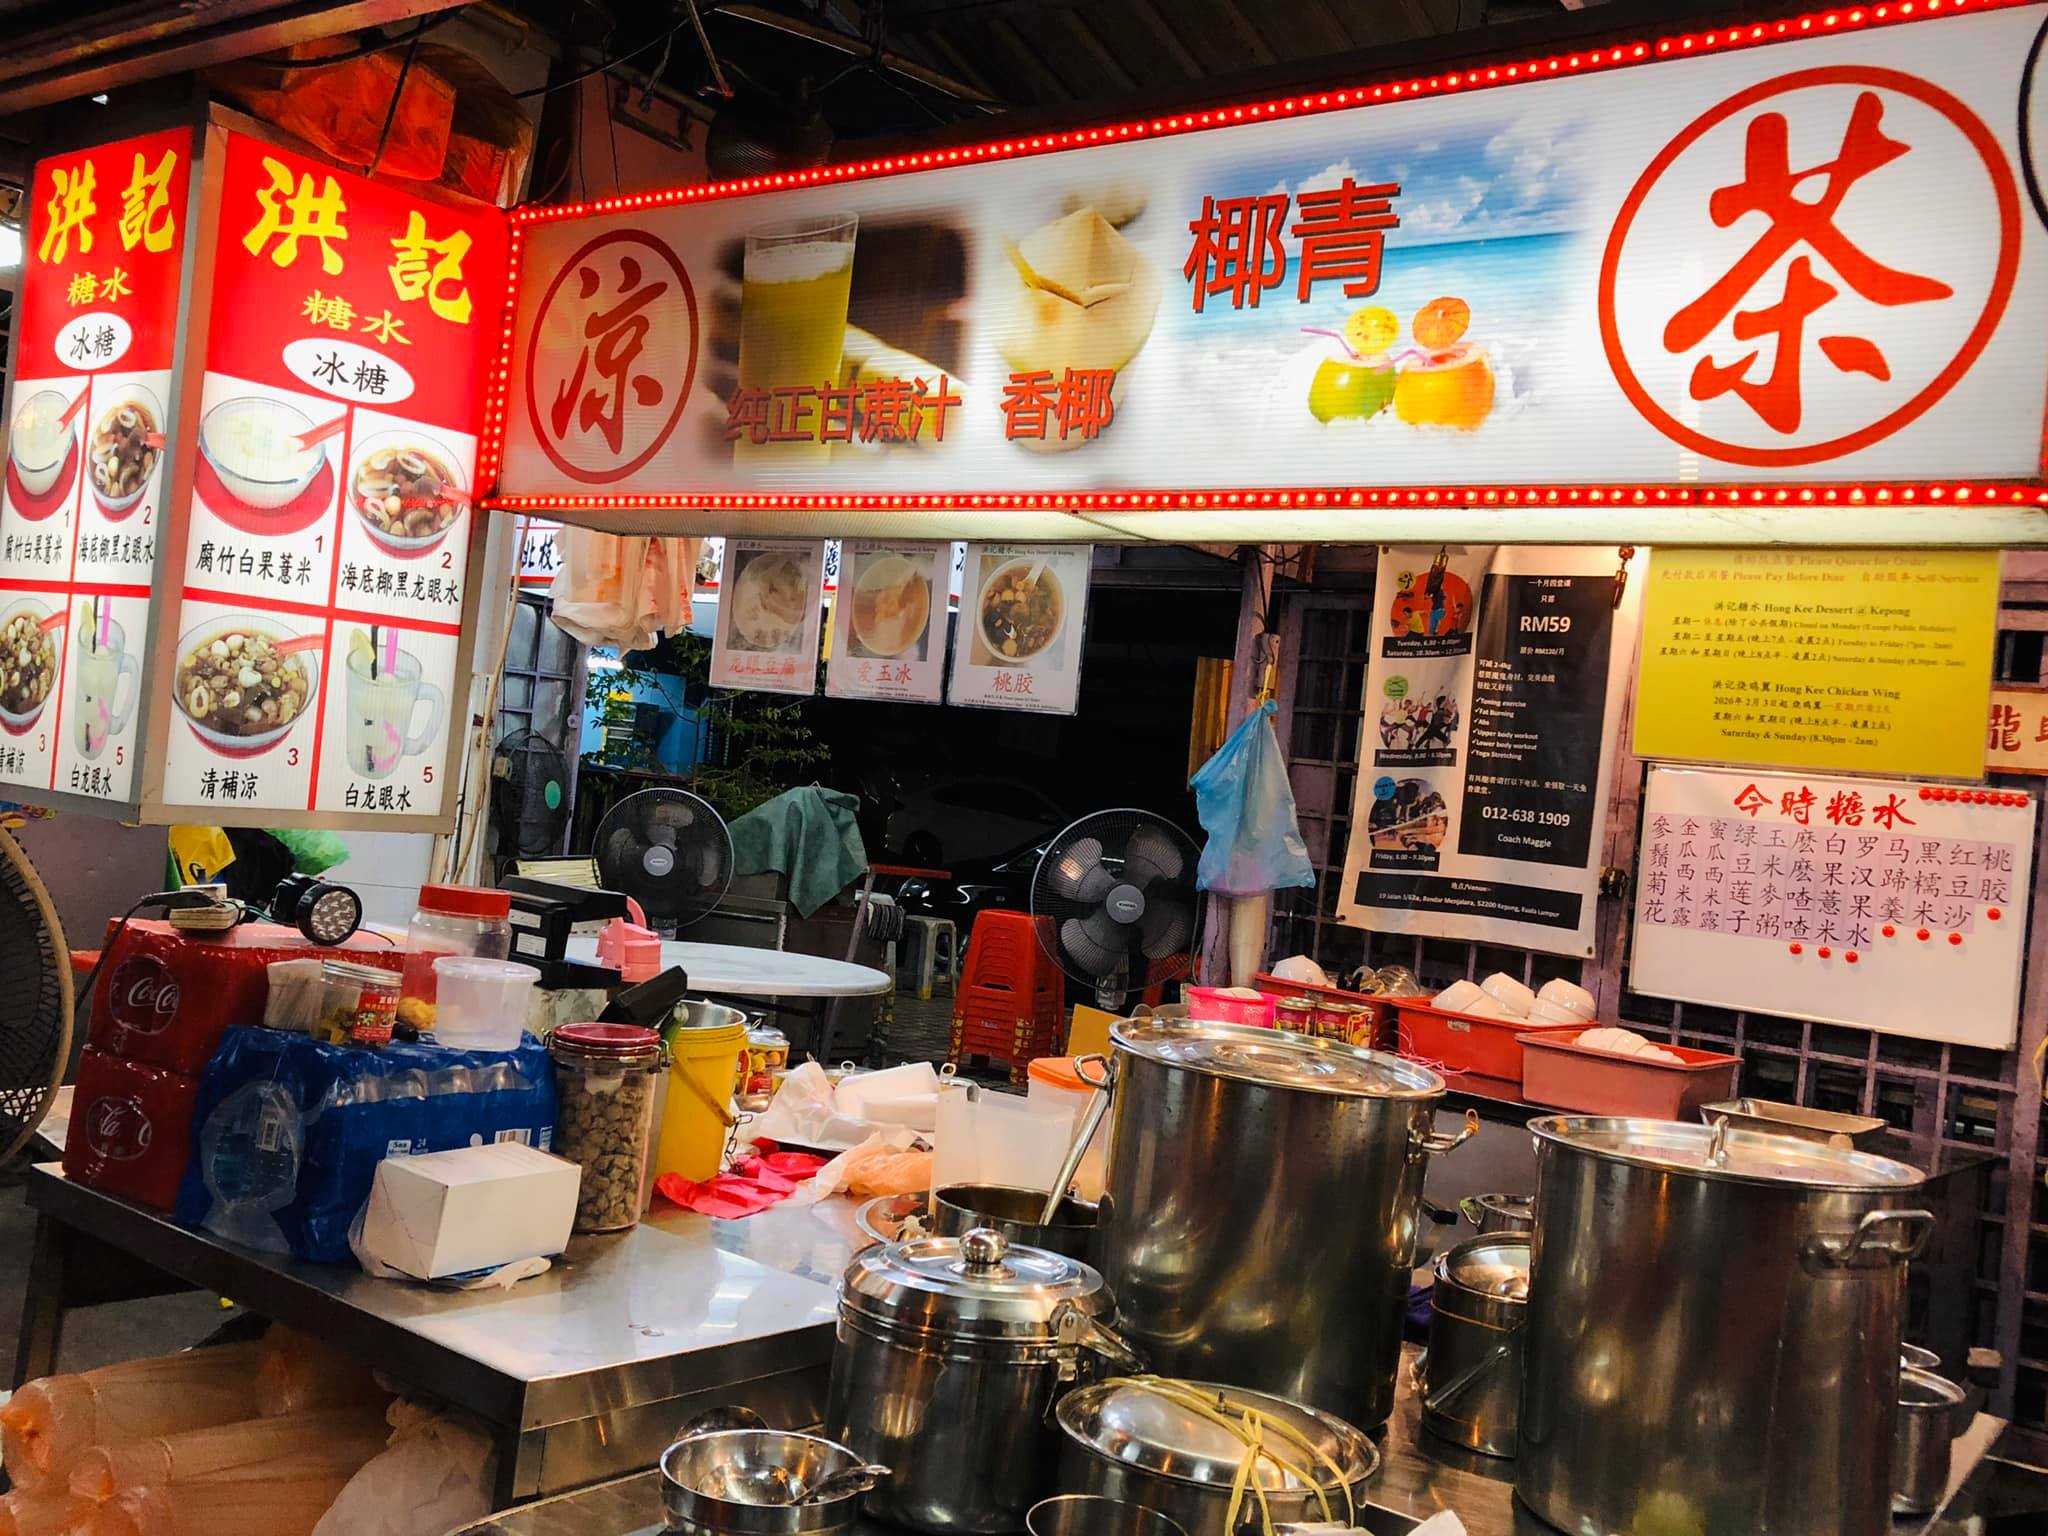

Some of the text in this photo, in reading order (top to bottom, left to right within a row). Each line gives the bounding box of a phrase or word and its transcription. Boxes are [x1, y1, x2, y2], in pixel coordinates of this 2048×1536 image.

[38, 148, 178, 265] 洪記
[242, 157, 473, 324] 洪記
[1184, 177, 1402, 314] 椰青
[1663, 91, 1953, 434] 茶
[66, 267, 133, 306] 糖水
[302, 289, 412, 345] 糖水
[69, 324, 117, 362] 冰糖
[312, 352, 390, 396] 冰糖
[724, 374, 964, 446] 纯正甘蔗汁
[1000, 366, 1116, 442] 香椰
[144, 505, 151, 525] 2
[315, 535, 323, 553] 1
[441, 552, 452, 569] 2
[340, 561, 460, 606] 海底椰黑龙眼水
[1520, 615, 1571, 633] RM59
[1764, 603, 1791, 614] Hong
[1794, 604, 1814, 613] Kee
[1816, 605, 1853, 614] Dessert
[1870, 606, 1911, 617] Kepong
[1775, 683, 1801, 695] Hong
[1805, 685, 1824, 695] Kee
[1827, 686, 1869, 697] Chicken
[1873, 688, 1901, 700] Wing
[39, 734, 46, 752] 3
[1721, 728, 1760, 739] Saturday
[1774, 732, 1807, 743] Sunday
[116, 746, 124, 766] 5
[287, 747, 299, 766] 3
[423, 766, 433, 783] 5
[71, 762, 112, 797] 白龙眼水
[200, 768, 259, 800] 清補涼
[345, 782, 412, 812] 白龙眼水
[1482, 806, 1570, 827] 012-638 1909
[1734, 783, 1917, 831] 今時糖水
[1497, 833, 1552, 849] Coach Maggie
[1671, 817, 1700, 926] 金瓜西米露
[1699, 819, 1728, 930] 蜜瓜西米露
[1726, 823, 1758, 933] 绿豆莲子
[1815, 831, 1846, 944] 白果薏米
[1912, 841, 1942, 926] 黑糯米
[1944, 843, 1977, 929] 红豆沙
[1978, 846, 2013, 904] 桃胶
[1477, 900, 1497, 909] 52200
[1847, 836, 1879, 948] 罗汉果水
